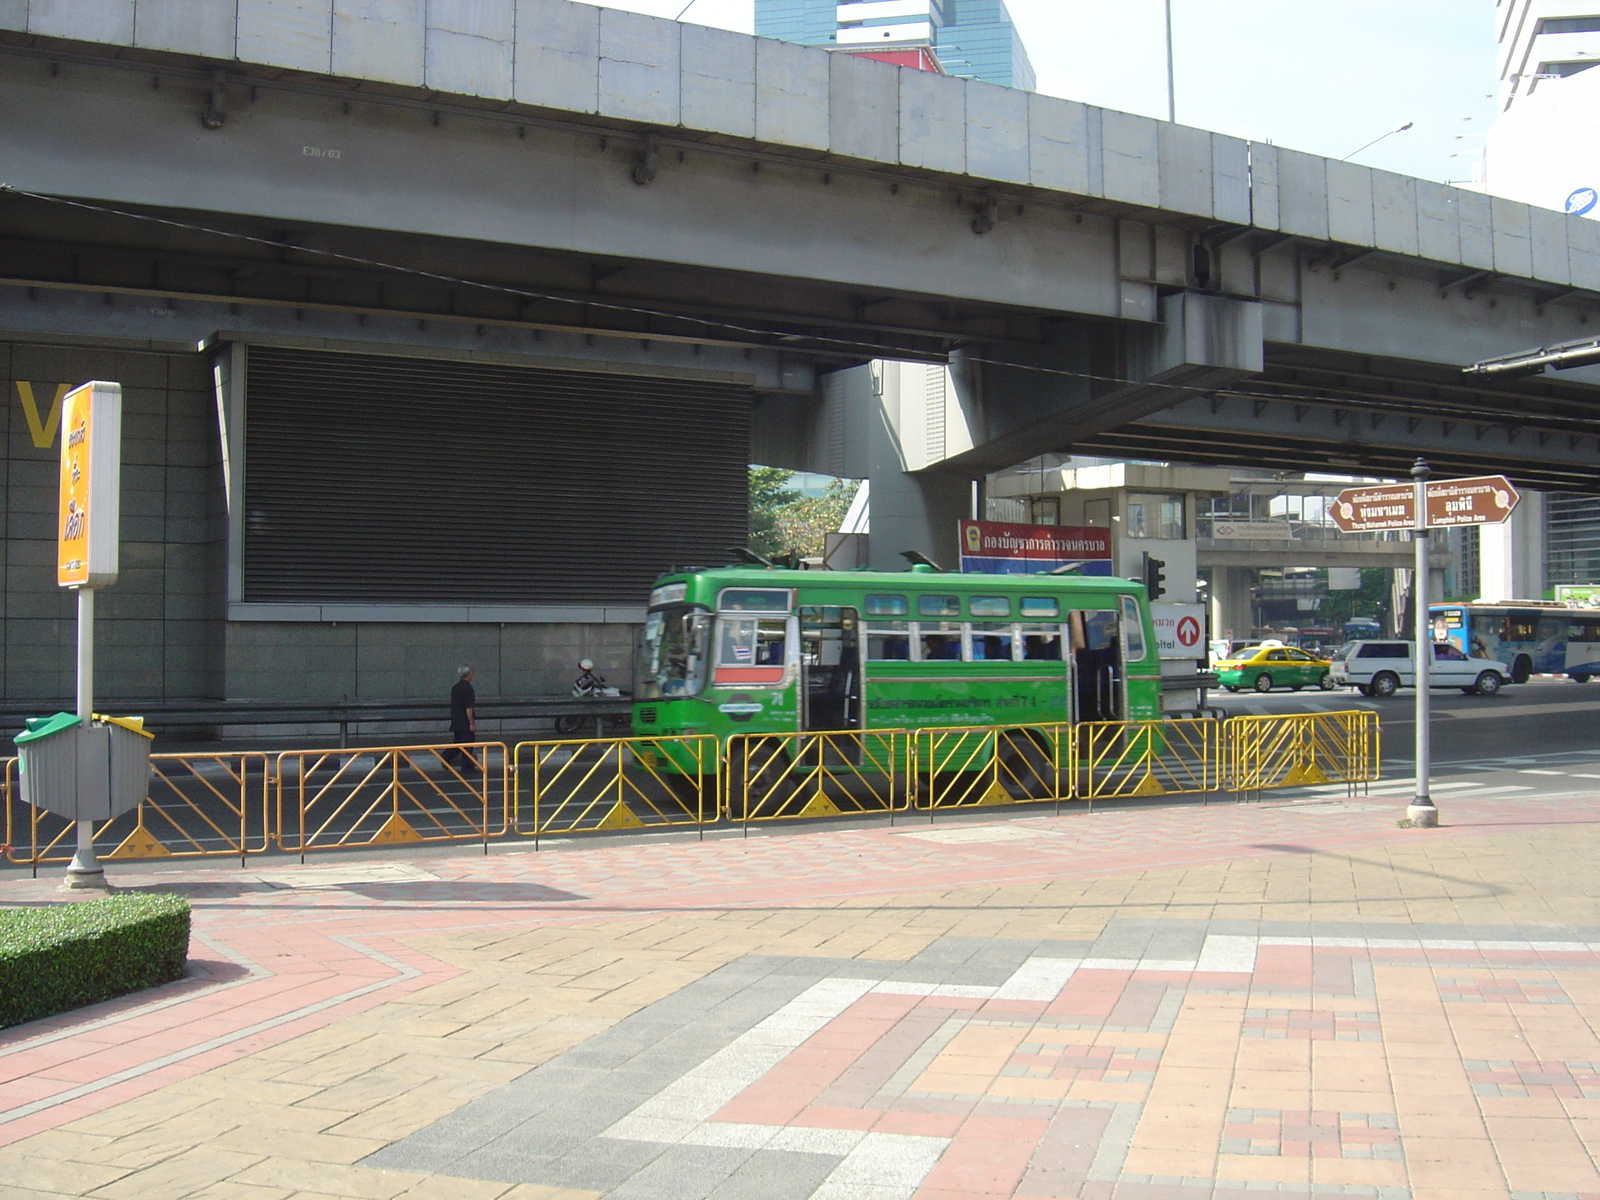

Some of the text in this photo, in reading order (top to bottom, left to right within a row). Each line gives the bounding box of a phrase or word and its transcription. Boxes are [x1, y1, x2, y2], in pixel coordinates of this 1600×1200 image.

[1445, 495, 1473, 516] ลุมพินี
[1388, 519, 1403, 527] Police
[1403, 518, 1415, 527] Area
[1457, 515, 1473, 523] Police
[1474, 514, 1486, 522] Area
[984, 531, 1105, 554] กองบัญชาการตำรวจนครบาล
